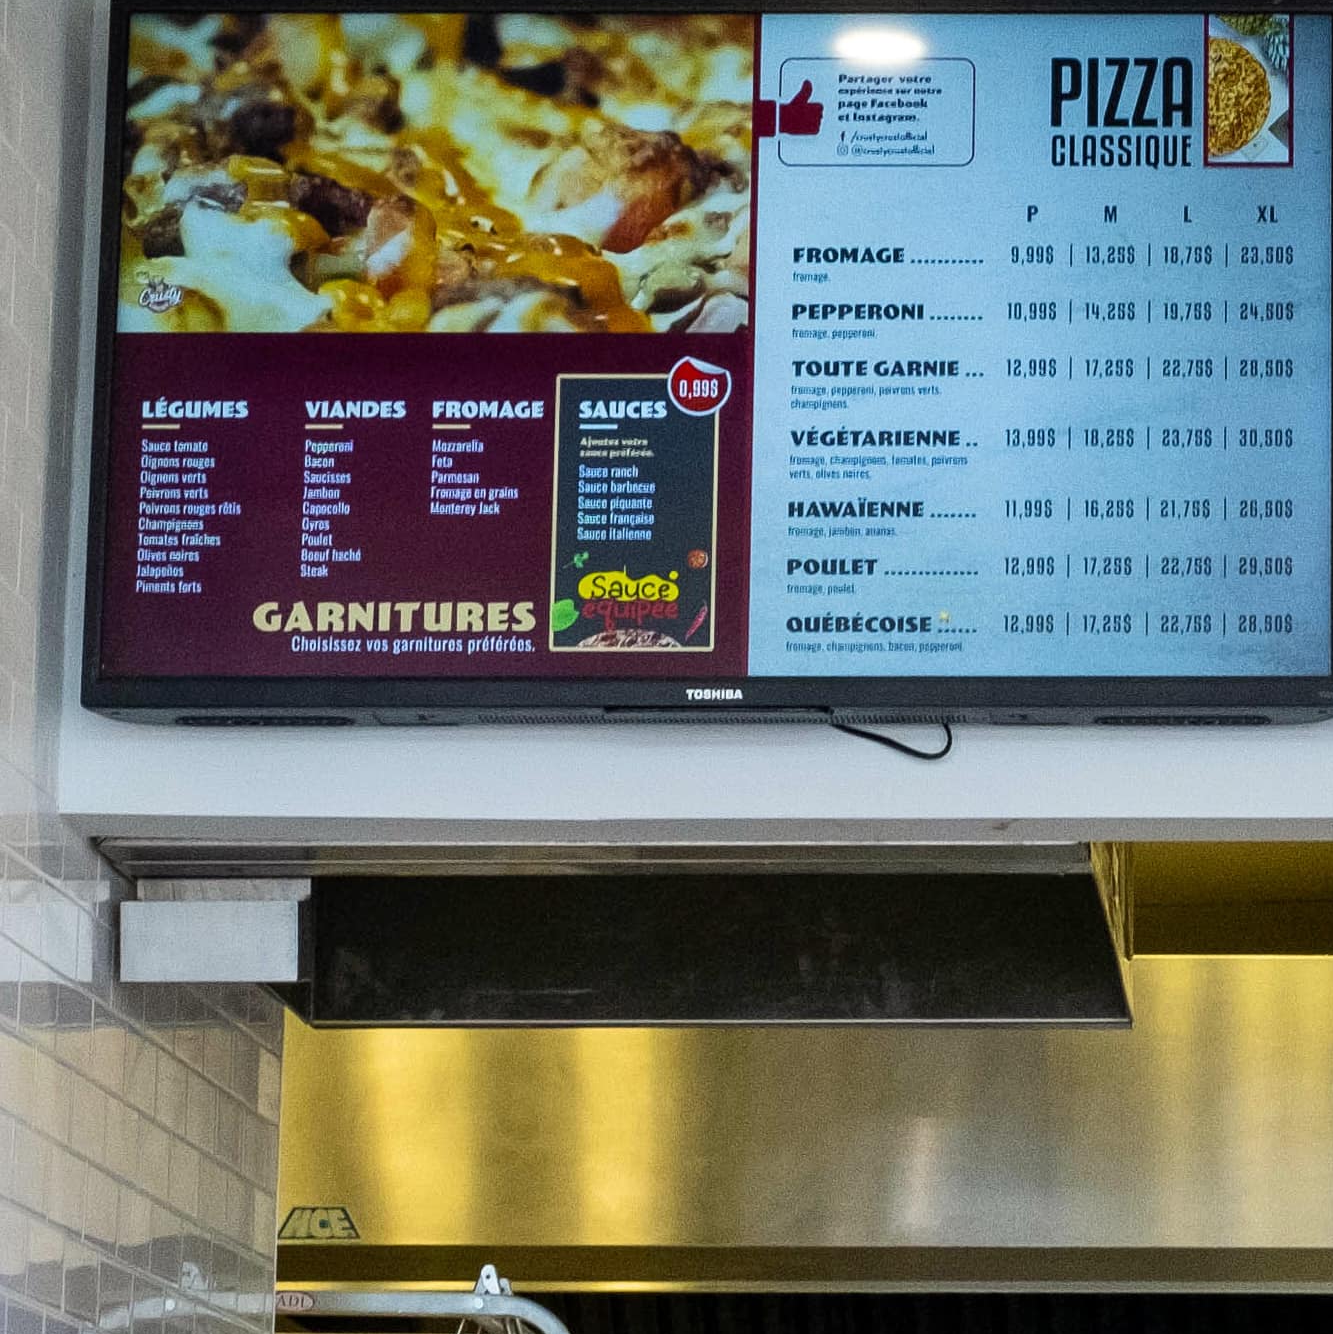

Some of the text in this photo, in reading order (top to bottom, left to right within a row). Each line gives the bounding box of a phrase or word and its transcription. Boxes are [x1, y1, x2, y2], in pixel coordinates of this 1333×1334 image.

[1050, 57, 1193, 128] PIZZA
[1051, 134, 1192, 168] CLASSIQUE
[1027, 206, 1278, 223] P M L XL
[793, 247, 904, 264] FROMAGE
[792, 304, 924, 320] PEPPERONI
[792, 360, 959, 376] TOUTE GARNIE
[679, 379, 718, 399] 0,99$
[142, 396, 248, 417] LÉGUMES
[305, 400, 406, 417] VIANDES
[432, 400, 544, 419] FROMAGE
[579, 400, 667, 419] SAUCES
[791, 425, 960, 447] VÉGÉTARIENNE
[788, 497, 924, 518] HAWAÏENNE
[787, 559, 877, 575] POULET
[592, 575, 670, 598] Sauce
[252, 601, 536, 633] GARNITURES
[787, 612, 932, 633] QUÉBÉCOISE
[291, 635, 536, 656] Choisissez vos garnitures préférées.
[686, 688, 743, 700] TOSHIBA
